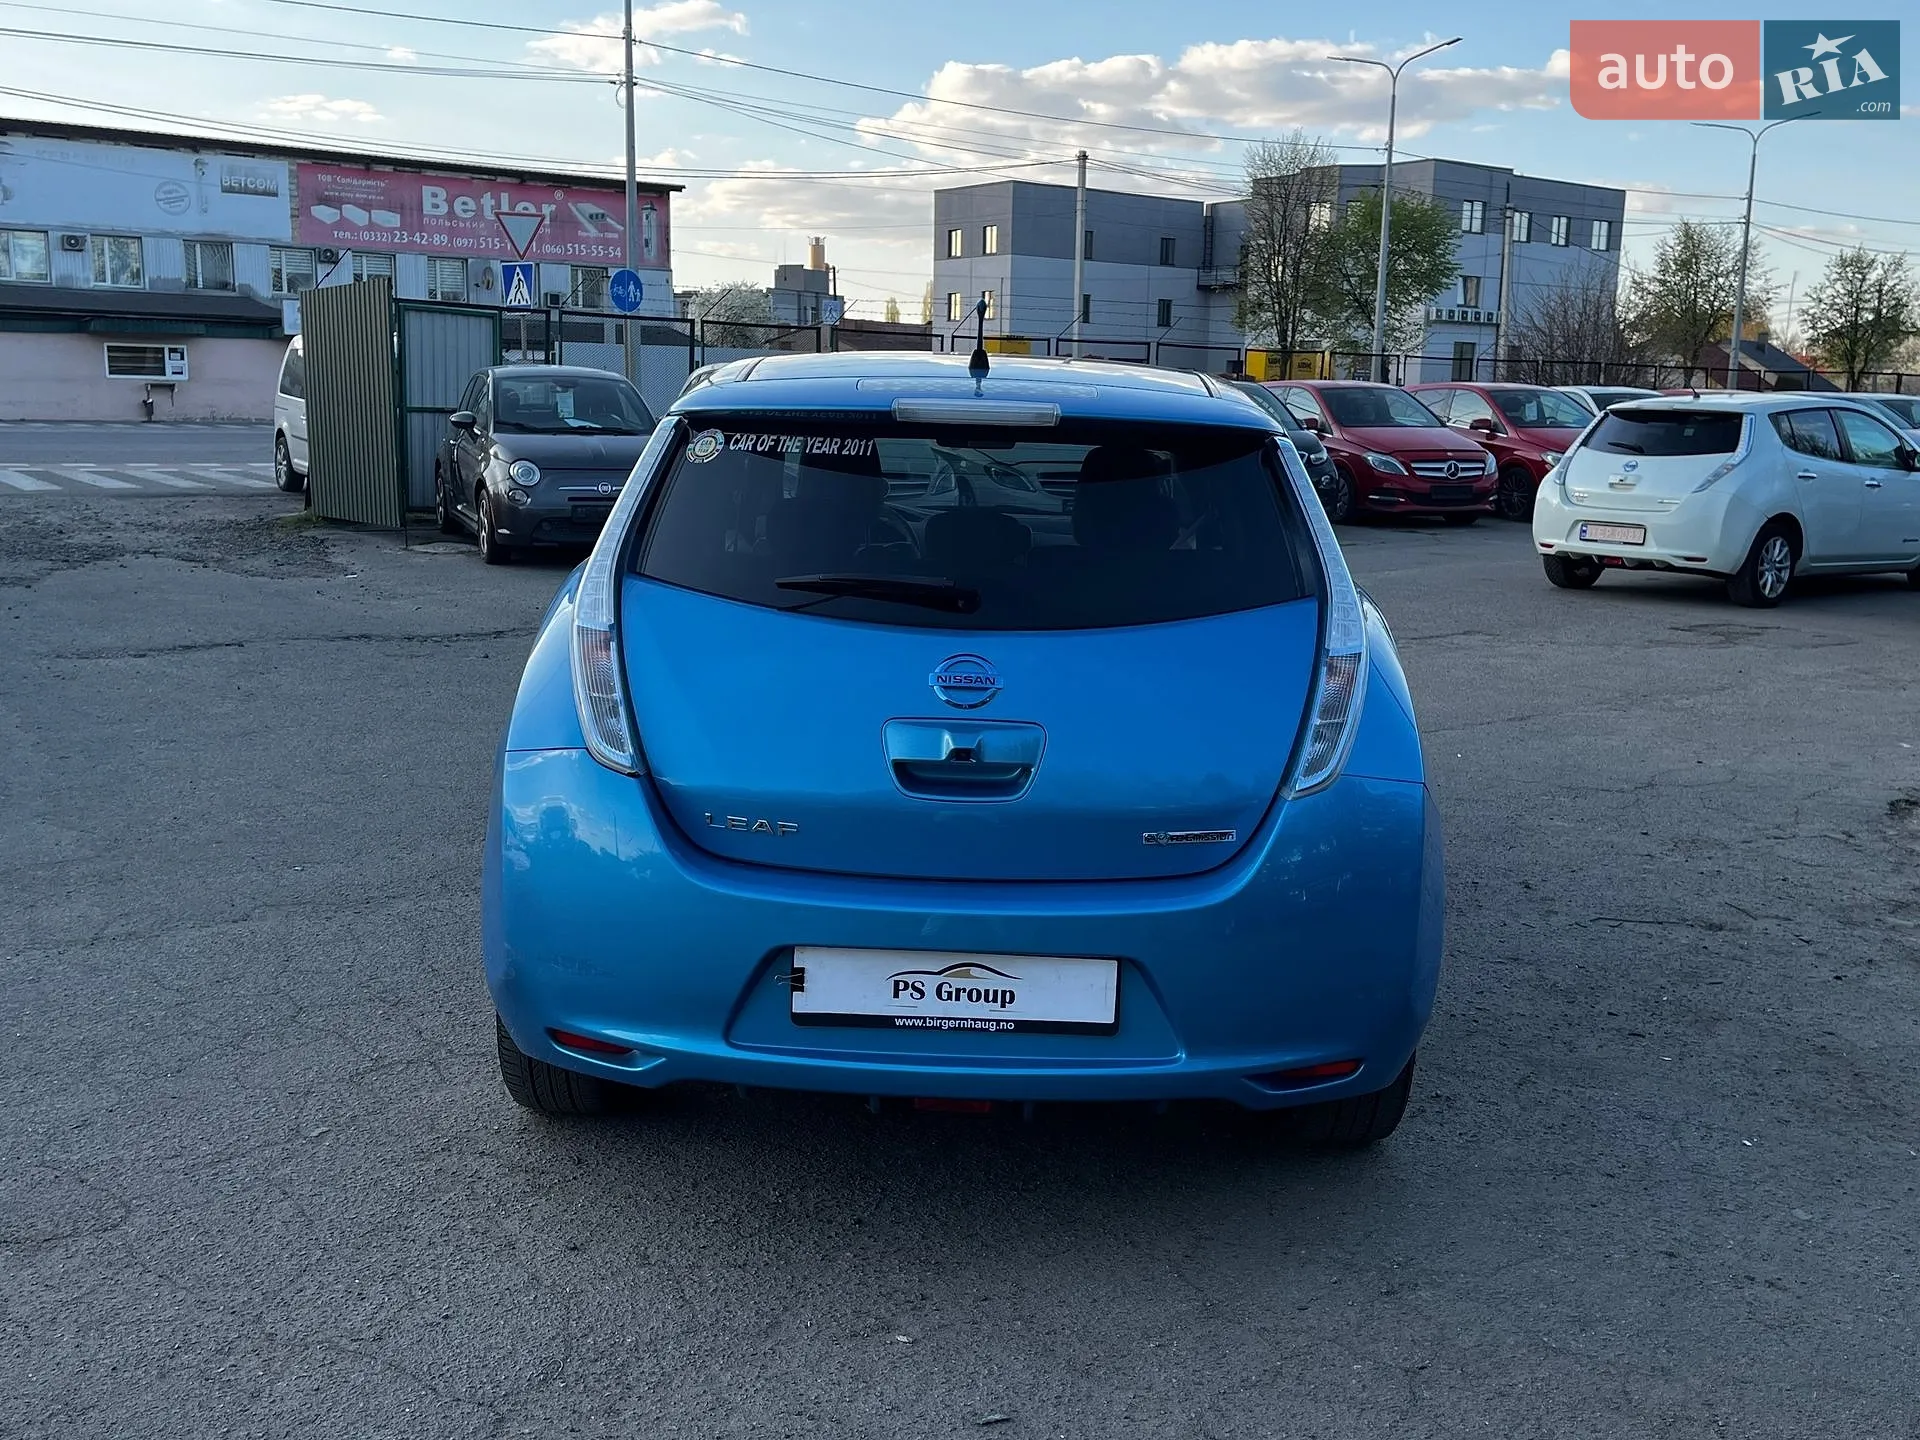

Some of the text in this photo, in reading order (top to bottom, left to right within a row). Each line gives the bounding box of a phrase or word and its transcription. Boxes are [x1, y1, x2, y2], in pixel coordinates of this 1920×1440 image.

[221, 175, 278, 191] BETCOM
[360, 231, 391, 243] (0332)
[453, 238, 477, 249] (097)
[542, 243, 565, 255] (066)
[567, 243, 622, 258] 515-55-54
[729, 434, 874, 456] CAR OF THE YEAR 2011
[936, 675, 996, 686] NISSAN
[704, 812, 798, 836] LEAF
[892, 979, 1016, 1008] PS Group
[894, 1017, 1015, 1031] www.birgernhaug.no
